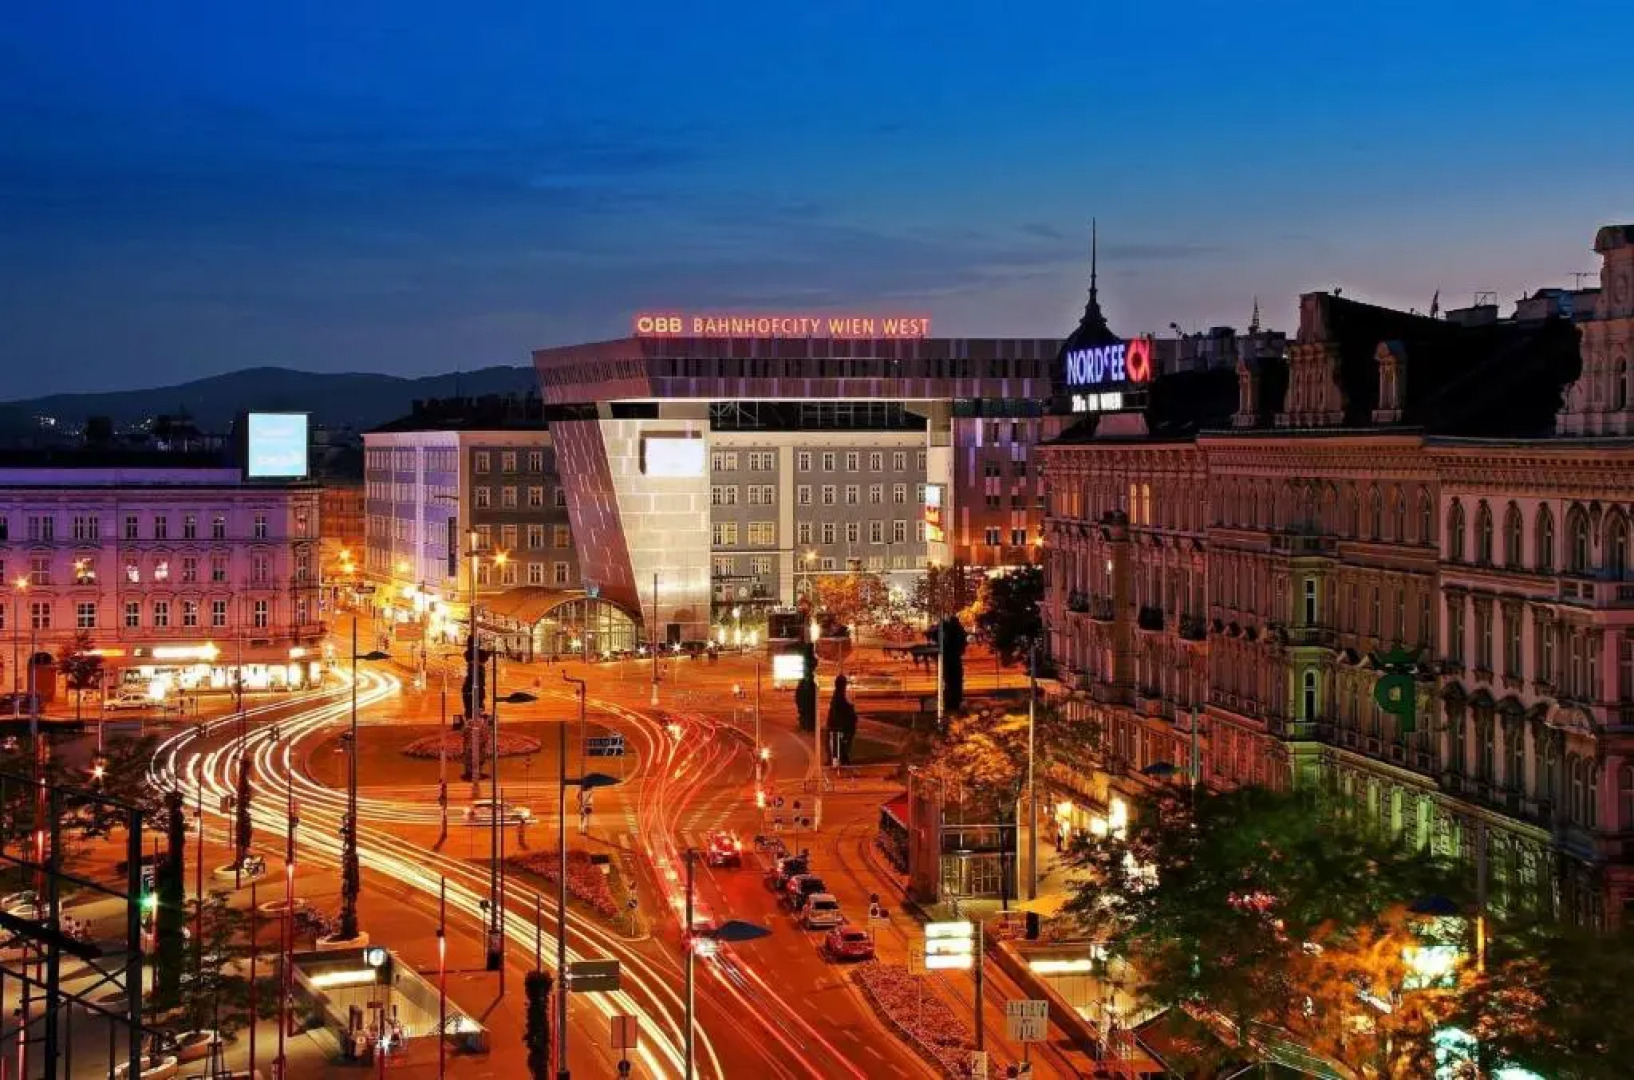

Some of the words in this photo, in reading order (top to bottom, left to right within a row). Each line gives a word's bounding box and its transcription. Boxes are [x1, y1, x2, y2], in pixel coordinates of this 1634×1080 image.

[693, 318, 820, 333] BAHNHOFCITY
[828, 318, 874, 334] WIEN
[882, 318, 929, 334] WEST
